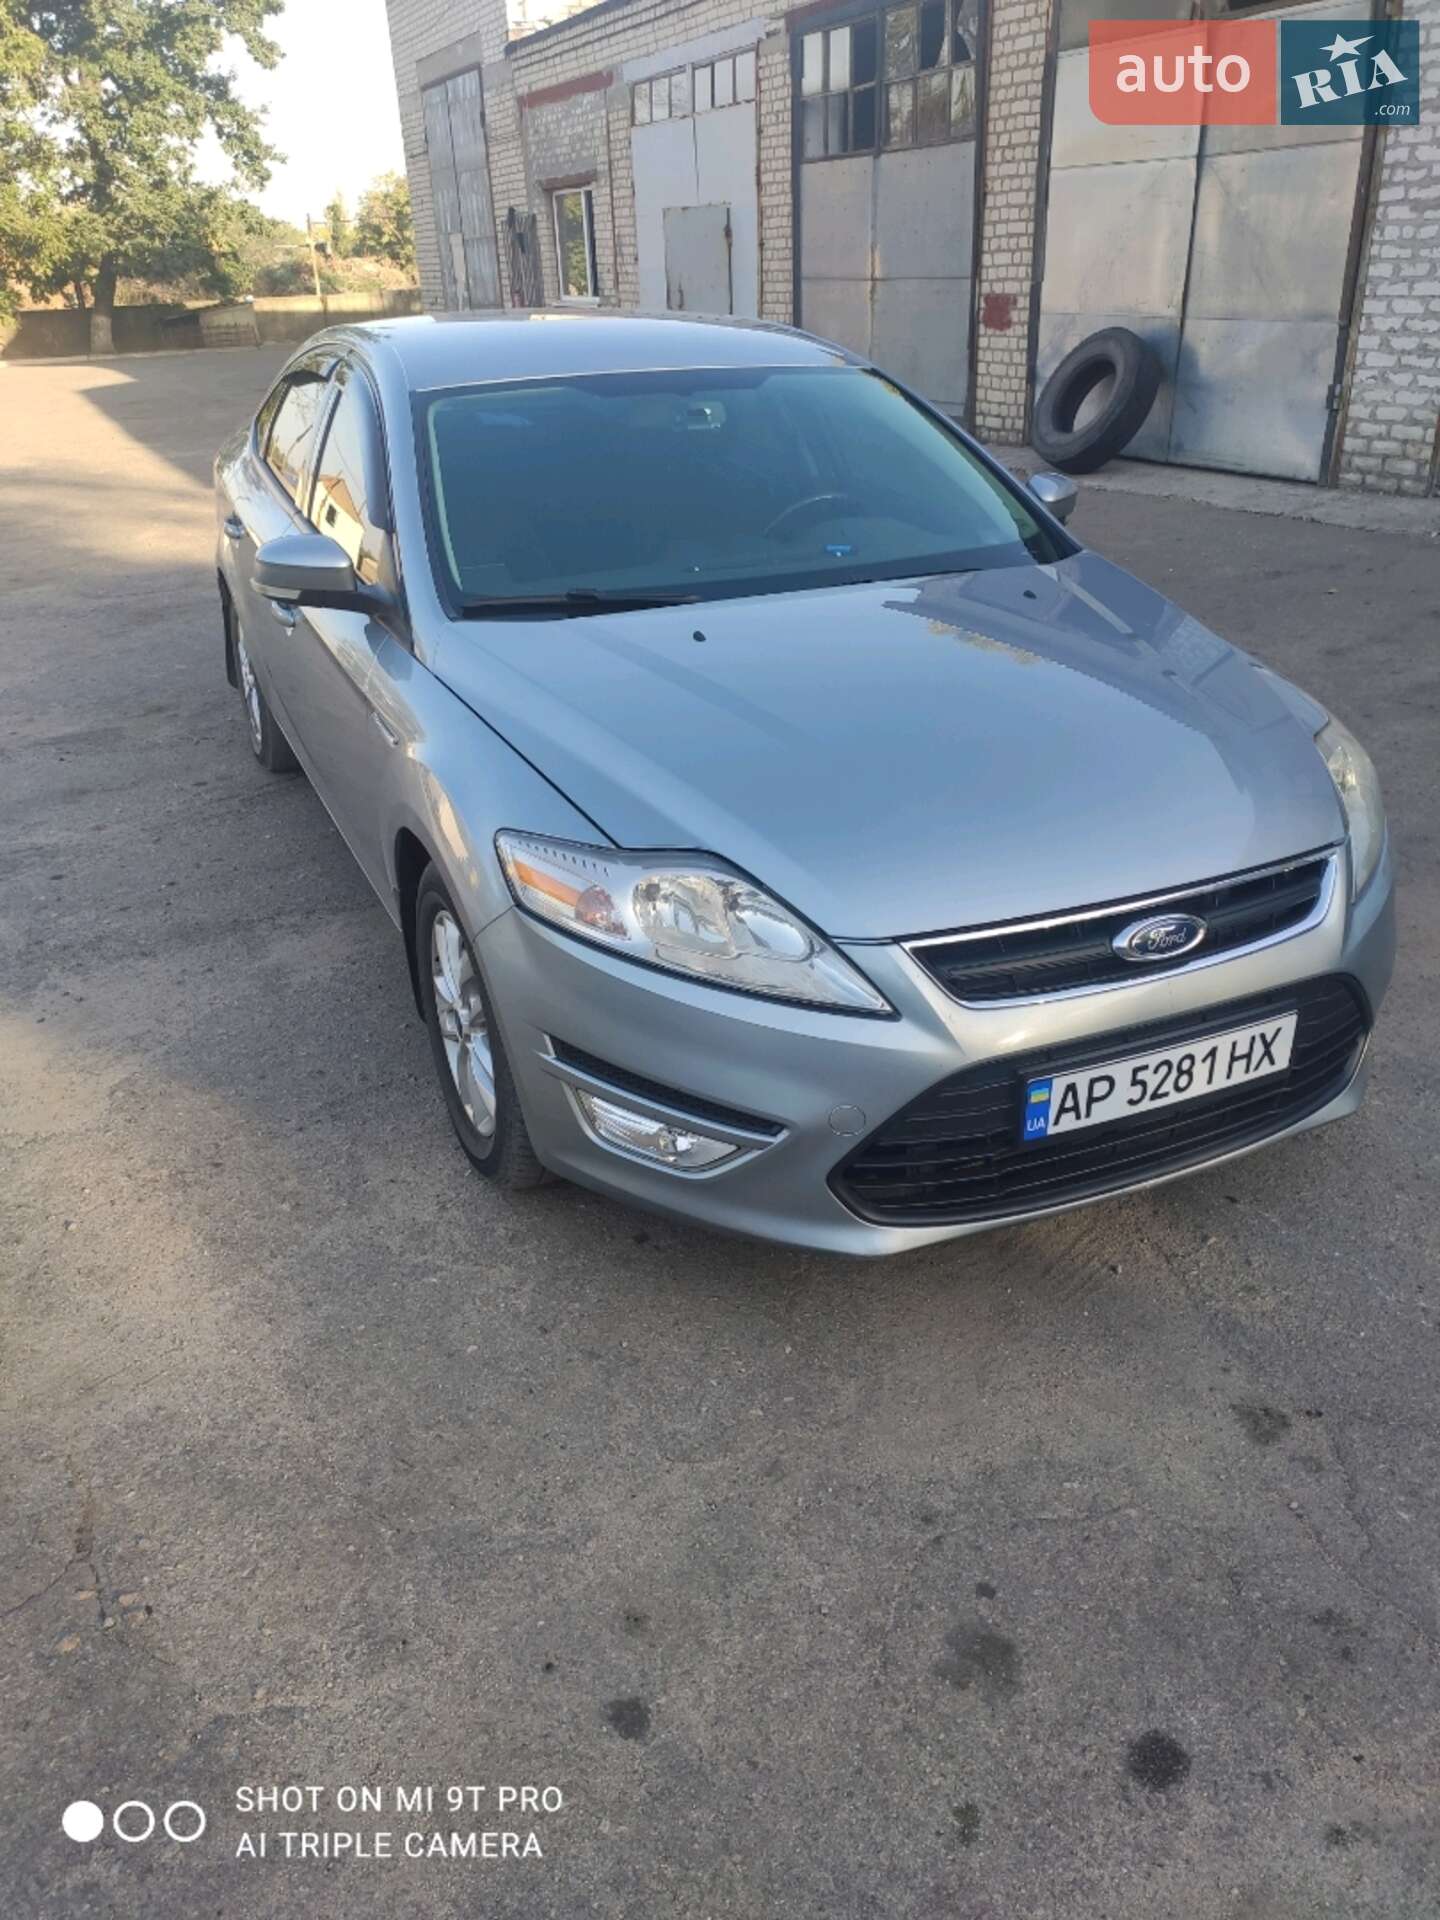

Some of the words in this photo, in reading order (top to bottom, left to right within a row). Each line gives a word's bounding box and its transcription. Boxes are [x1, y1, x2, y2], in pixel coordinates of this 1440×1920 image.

[1148, 925, 1187, 950] Ford
[1053, 1074, 1116, 1126] AP
[1126, 1046, 1218, 1106] 5281
[1226, 1027, 1282, 1080] HX
[1027, 1118, 1046, 1132] UA
